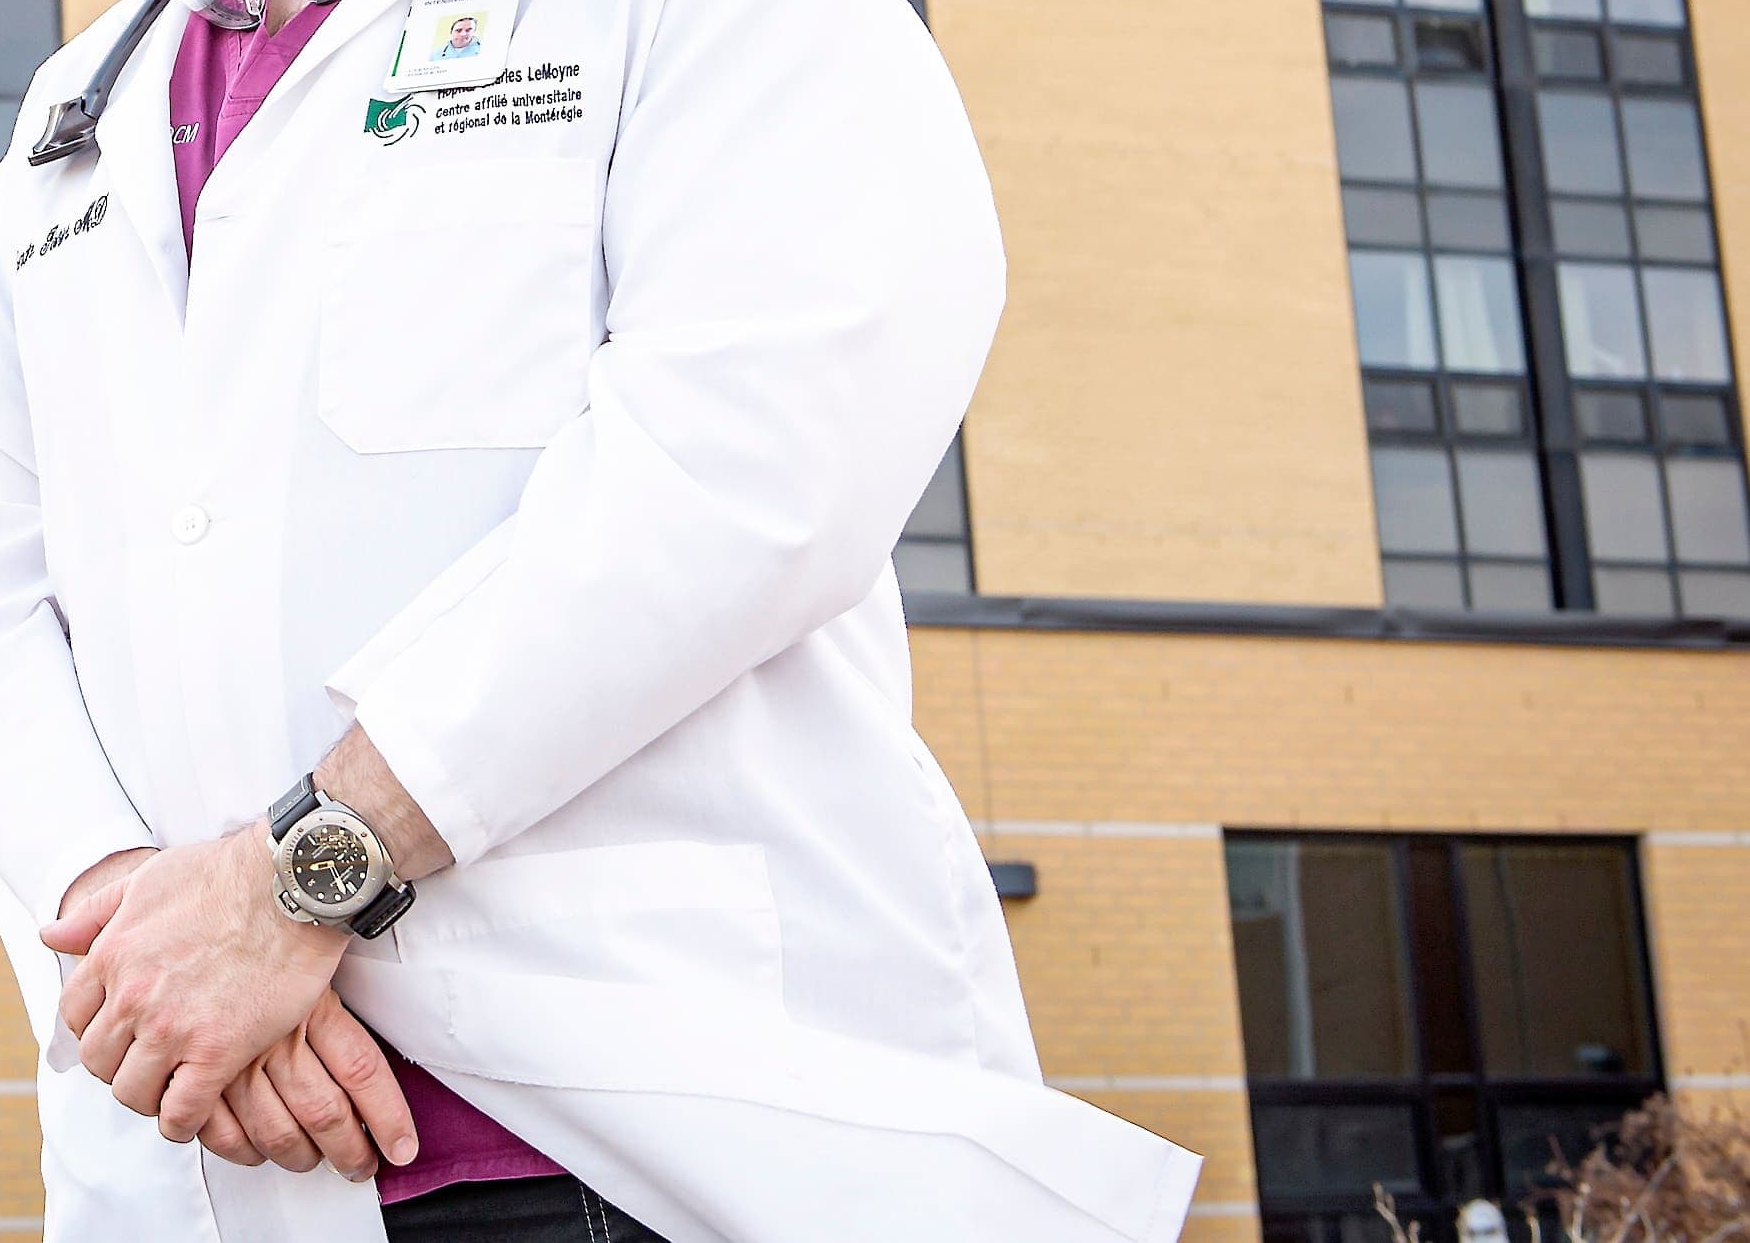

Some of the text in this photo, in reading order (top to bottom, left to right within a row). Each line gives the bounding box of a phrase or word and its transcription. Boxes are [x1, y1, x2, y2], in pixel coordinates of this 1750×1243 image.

[528, 63, 580, 82] LeMoyne
[436, 88, 582, 119] Centre affilié universitaire
[434, 105, 583, 134] et régional de la Montérégie
